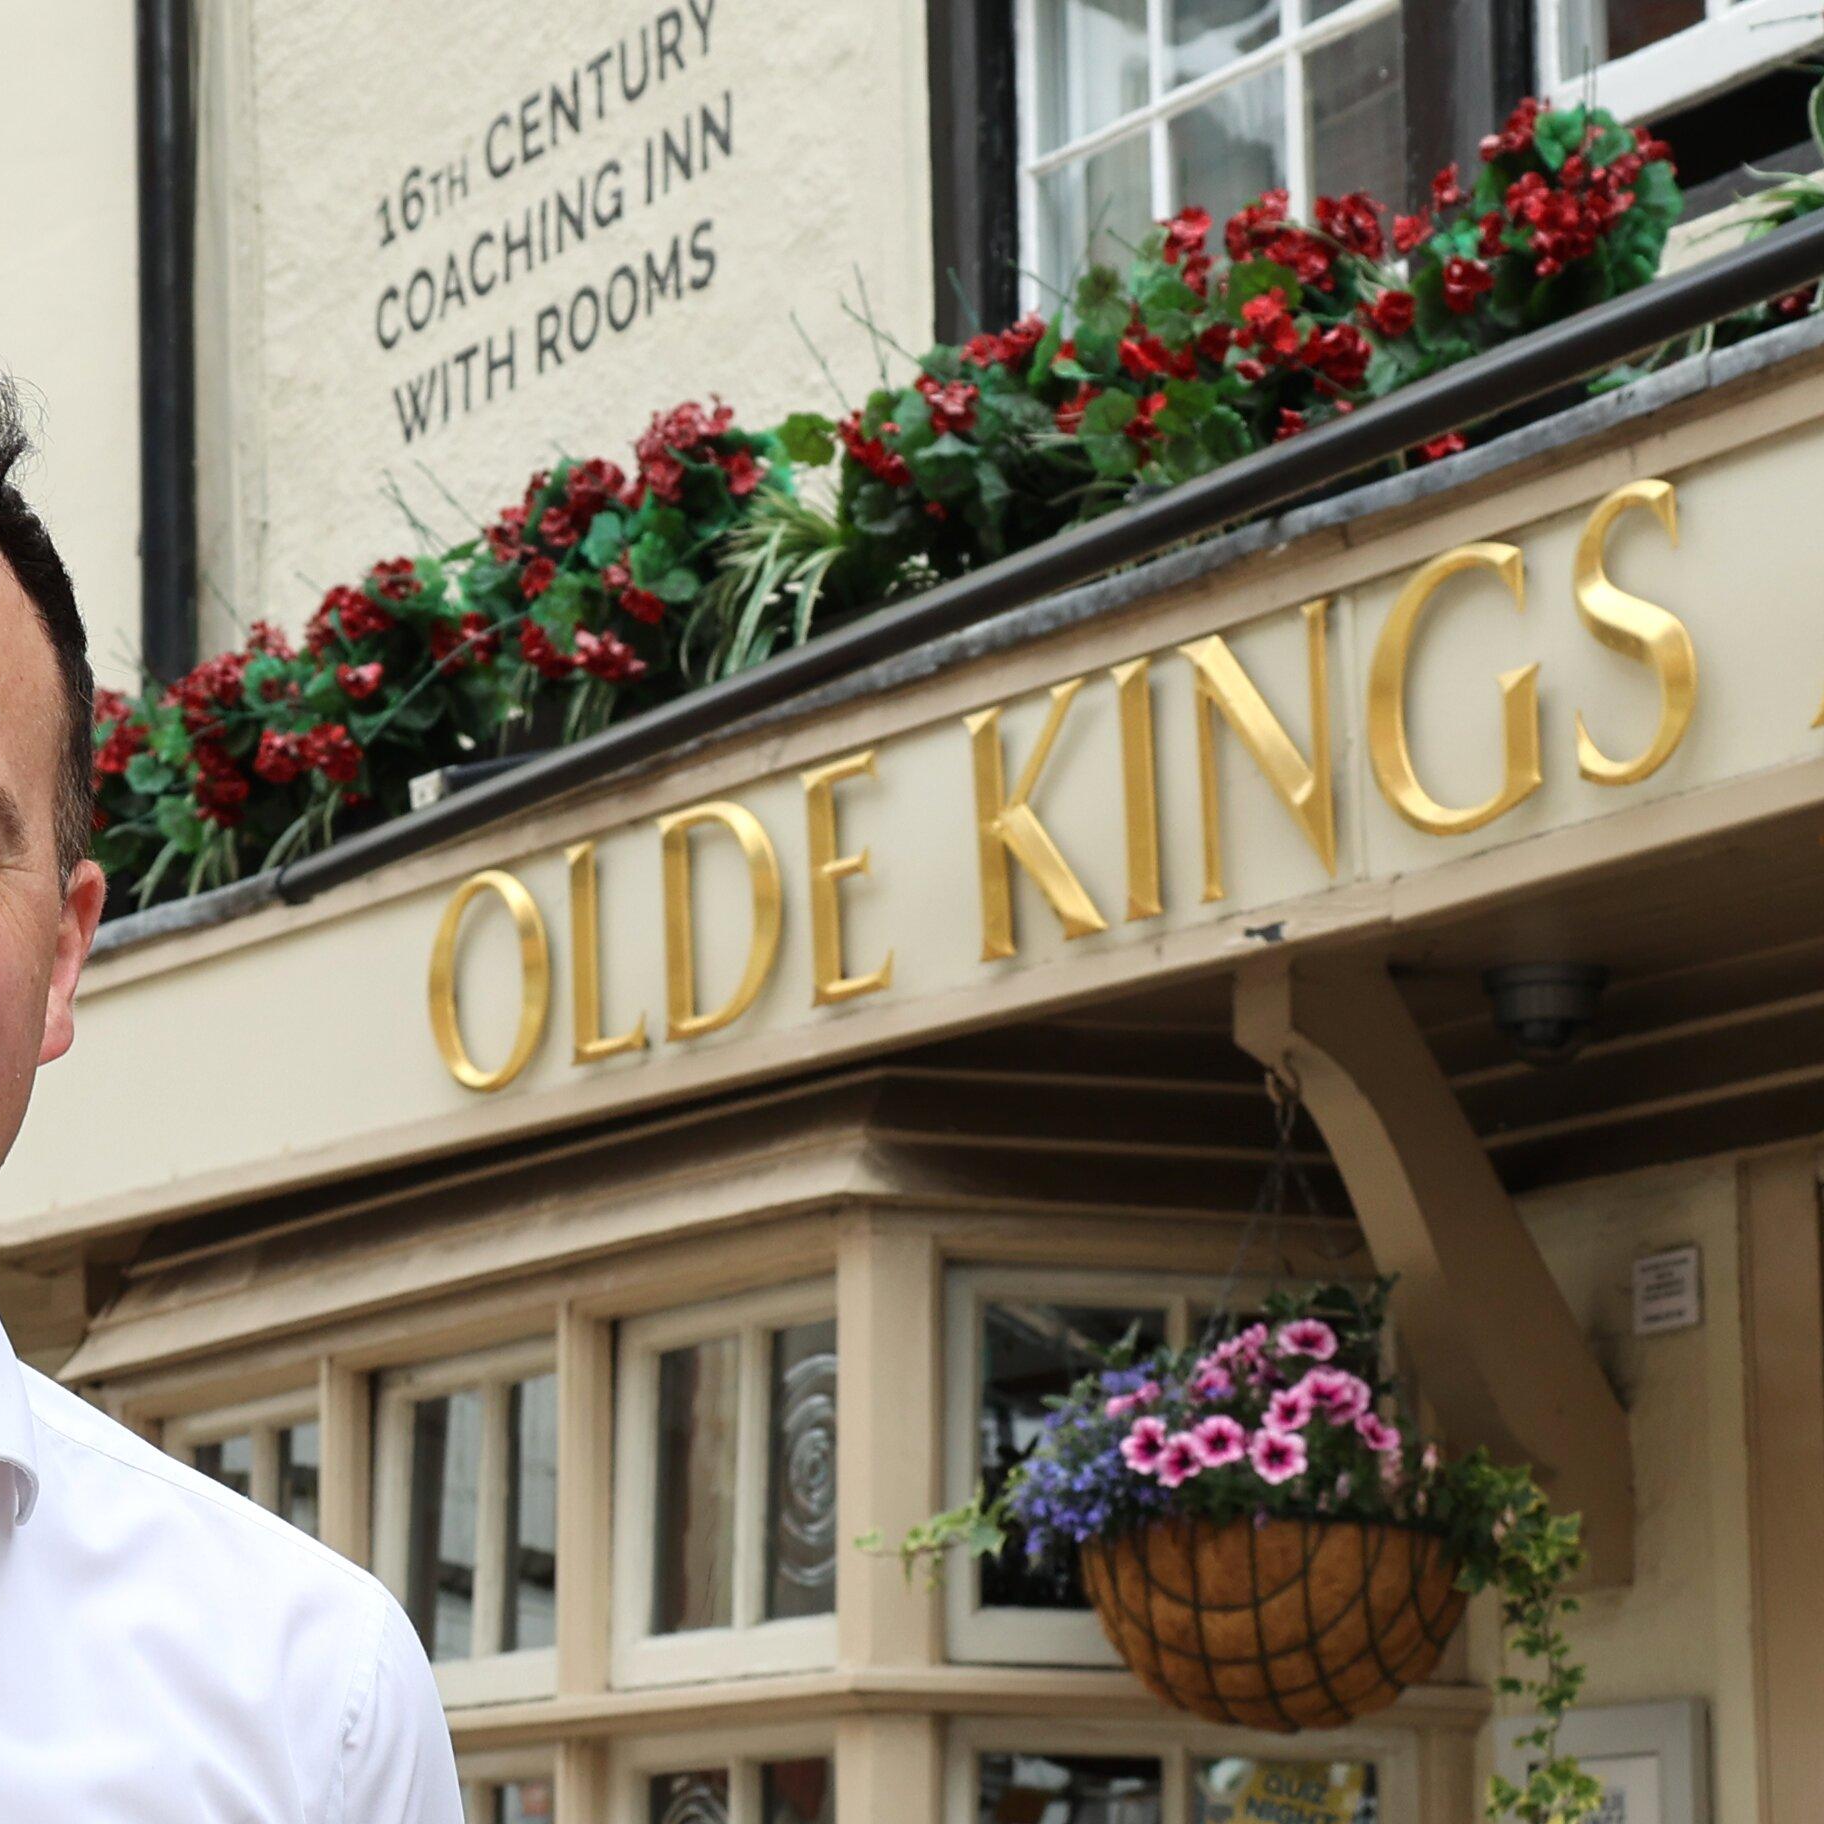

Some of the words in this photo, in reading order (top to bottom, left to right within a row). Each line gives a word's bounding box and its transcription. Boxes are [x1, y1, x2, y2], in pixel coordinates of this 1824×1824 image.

[375, 160, 624, 350] COACHING
[643, 90, 733, 204] INN
[378, 155, 469, 247] 16TH
[485, 0, 716, 180] CENTURY
[392, 327, 517, 444] WITH
[537, 219, 717, 374] ROOMS
[428, 748, 896, 1093] OLDE
[963, 477, 1698, 962] KINGS
